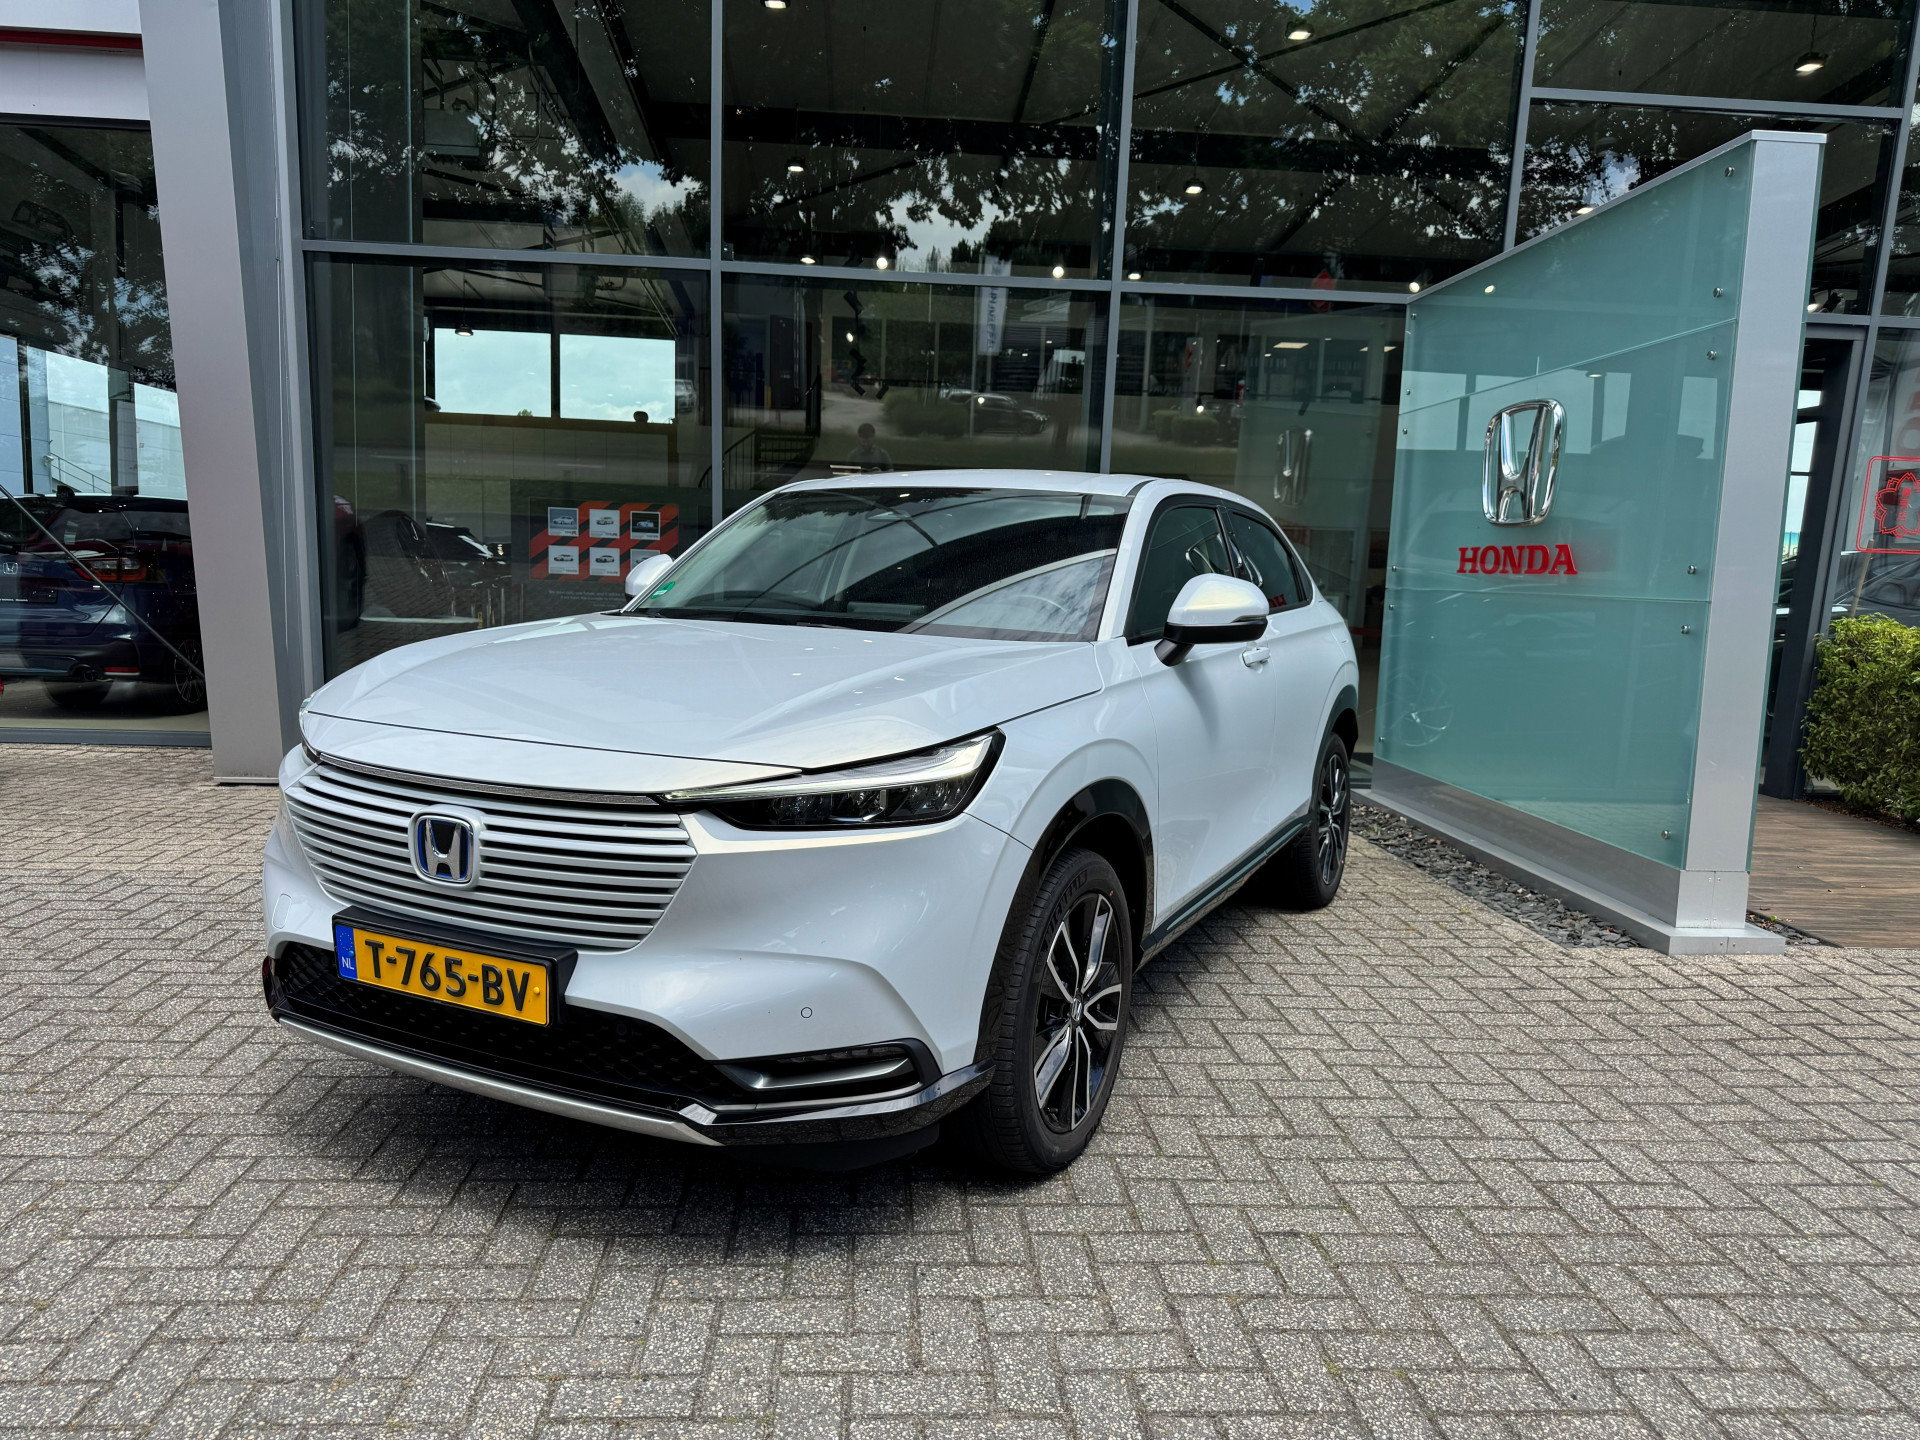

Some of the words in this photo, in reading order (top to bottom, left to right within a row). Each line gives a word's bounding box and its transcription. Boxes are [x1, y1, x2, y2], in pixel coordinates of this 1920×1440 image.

[1456, 544, 1578, 575] HONDA
[341, 956, 355, 971] NL
[365, 939, 530, 1012] T-765-BV
